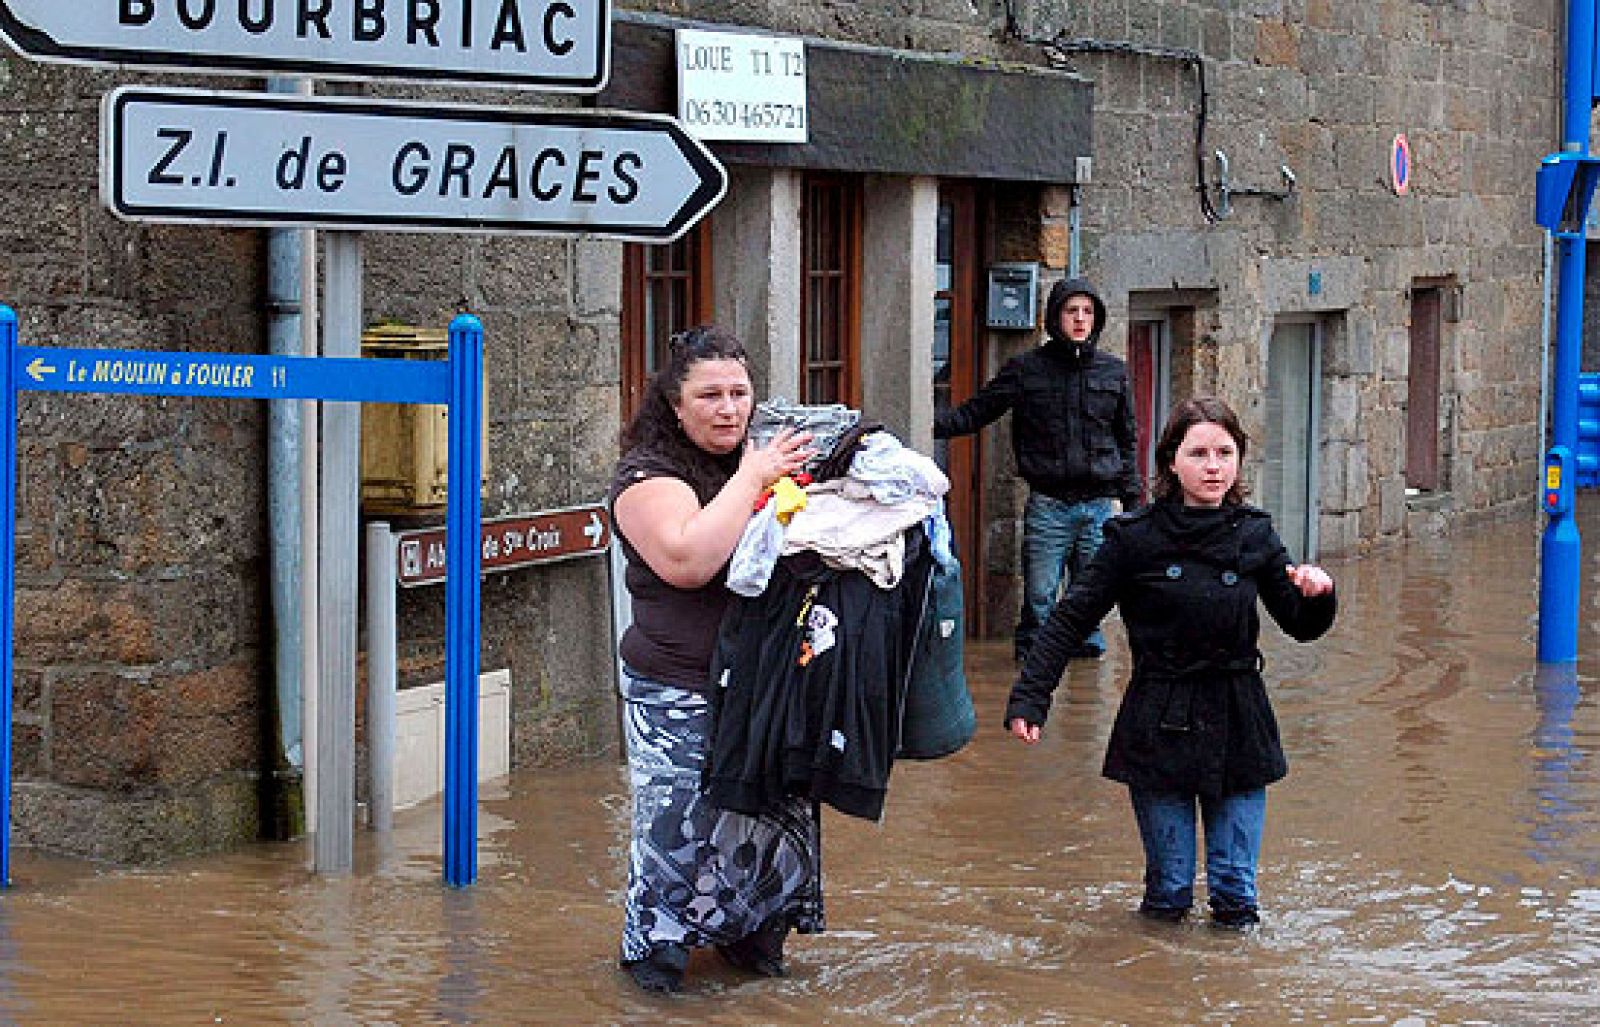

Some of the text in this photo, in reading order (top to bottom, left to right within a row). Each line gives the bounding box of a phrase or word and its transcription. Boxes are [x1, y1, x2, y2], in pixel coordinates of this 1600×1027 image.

[682, 43, 804, 77] LOUE T1 T2
[147, 127, 644, 205] Z.I. de GRACES
[66, 360, 88, 382] Le
[92, 359, 168, 386] MOULIN
[185, 363, 255, 388] FOULER
[482, 534, 499, 560] de
[526, 525, 560, 552] Croix
